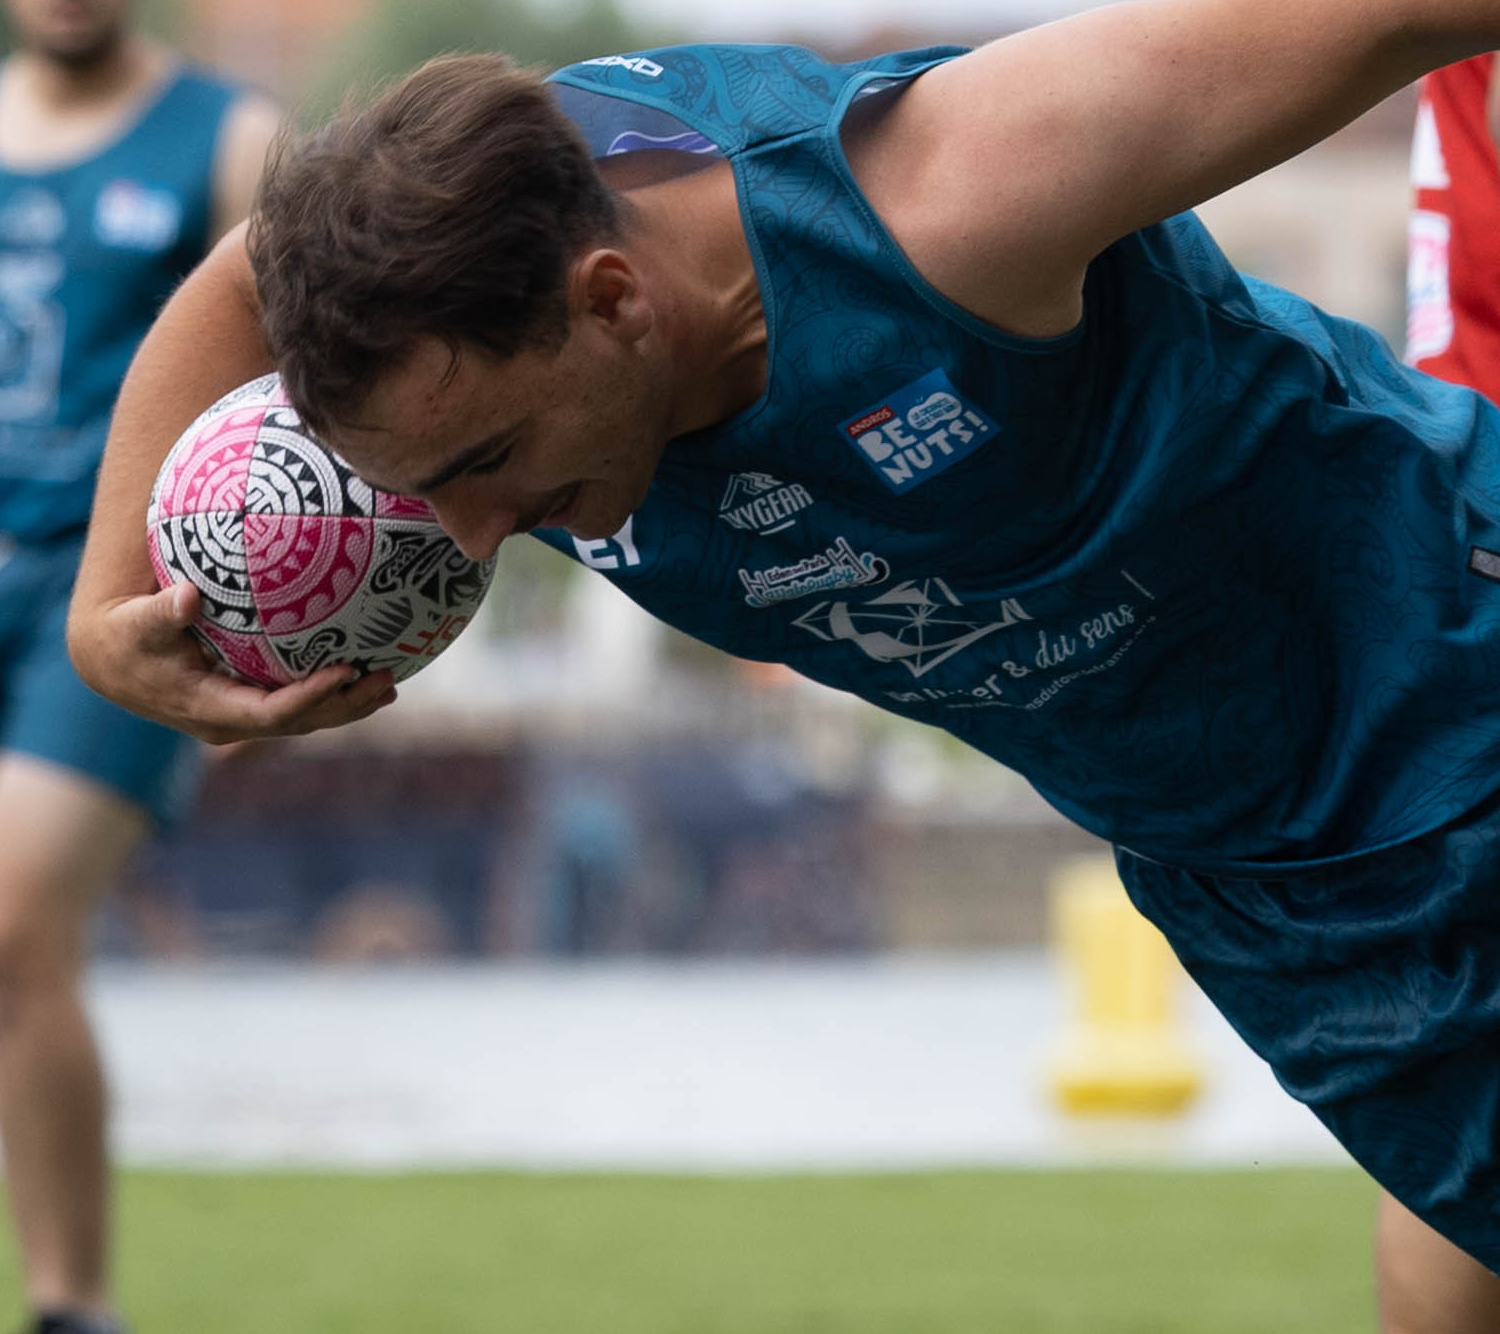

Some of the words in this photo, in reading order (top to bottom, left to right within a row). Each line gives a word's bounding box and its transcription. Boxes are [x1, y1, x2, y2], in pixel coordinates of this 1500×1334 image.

[857, 417, 917, 463] BE
[880, 410, 988, 485] NUTS!
[572, 513, 640, 569] EY
[767, 566, 793, 582] Eden
[803, 556, 828, 572] Park
[1035, 630, 1077, 669] du
[1080, 603, 1135, 648] sens
